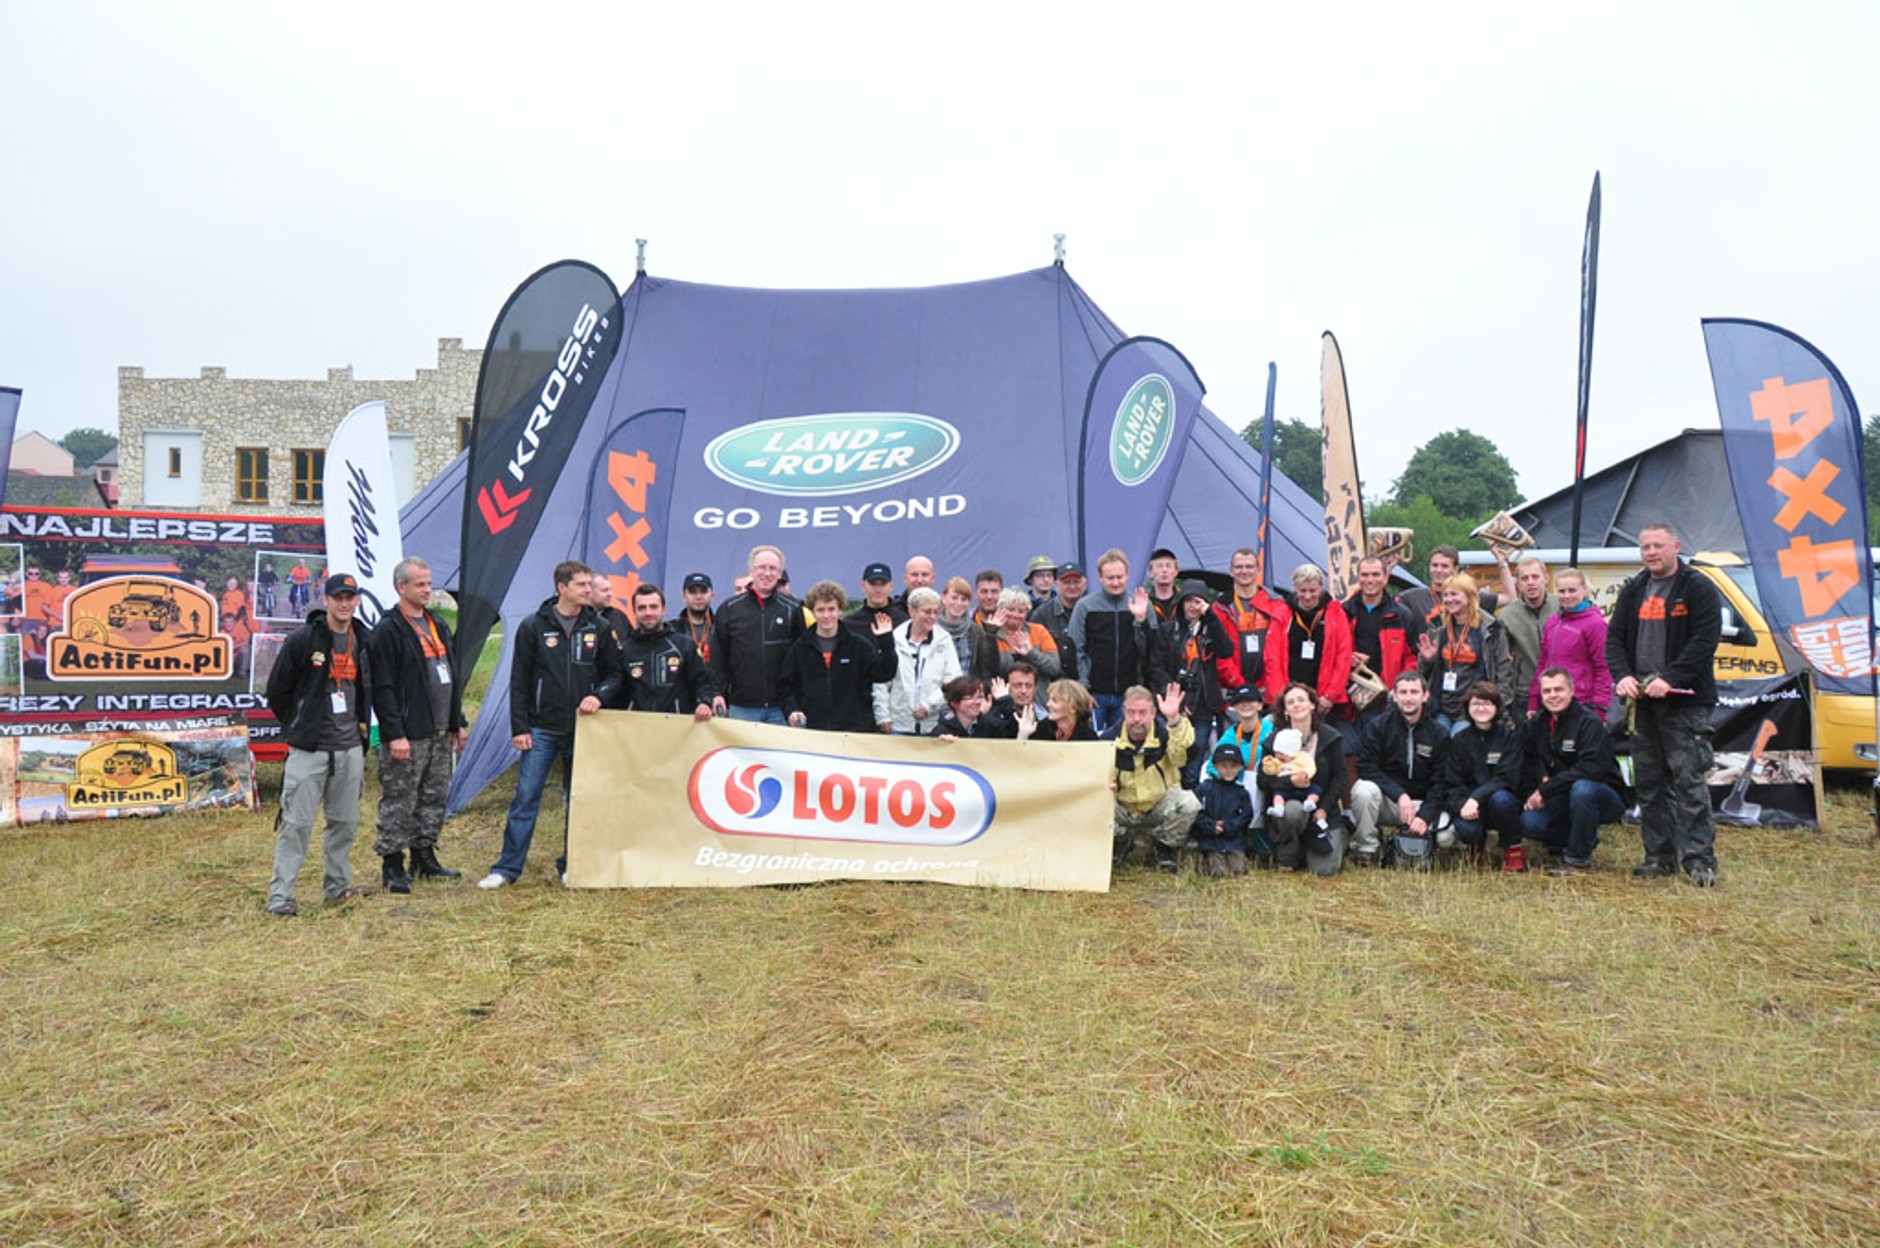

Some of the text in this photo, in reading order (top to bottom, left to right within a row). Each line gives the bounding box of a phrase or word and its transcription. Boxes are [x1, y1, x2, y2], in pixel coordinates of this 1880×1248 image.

[575, 317, 609, 385] BIKES
[507, 303, 598, 482] KROSS
[761, 428, 878, 453] LAND
[1118, 405, 1147, 459] LAND
[1135, 394, 1167, 463] ROVER
[769, 446, 915, 476] ROVER
[693, 494, 967, 529] GO BEYOND
[0, 514, 275, 544] NAJLEPSZE
[60, 644, 222, 674] ActiFun.pl
[146, 721, 171, 731] NA
[73, 782, 182, 805] ActiFun.pl
[792, 770, 957, 830] LOTOS
[694, 845, 863, 874] Bezgraniczna
